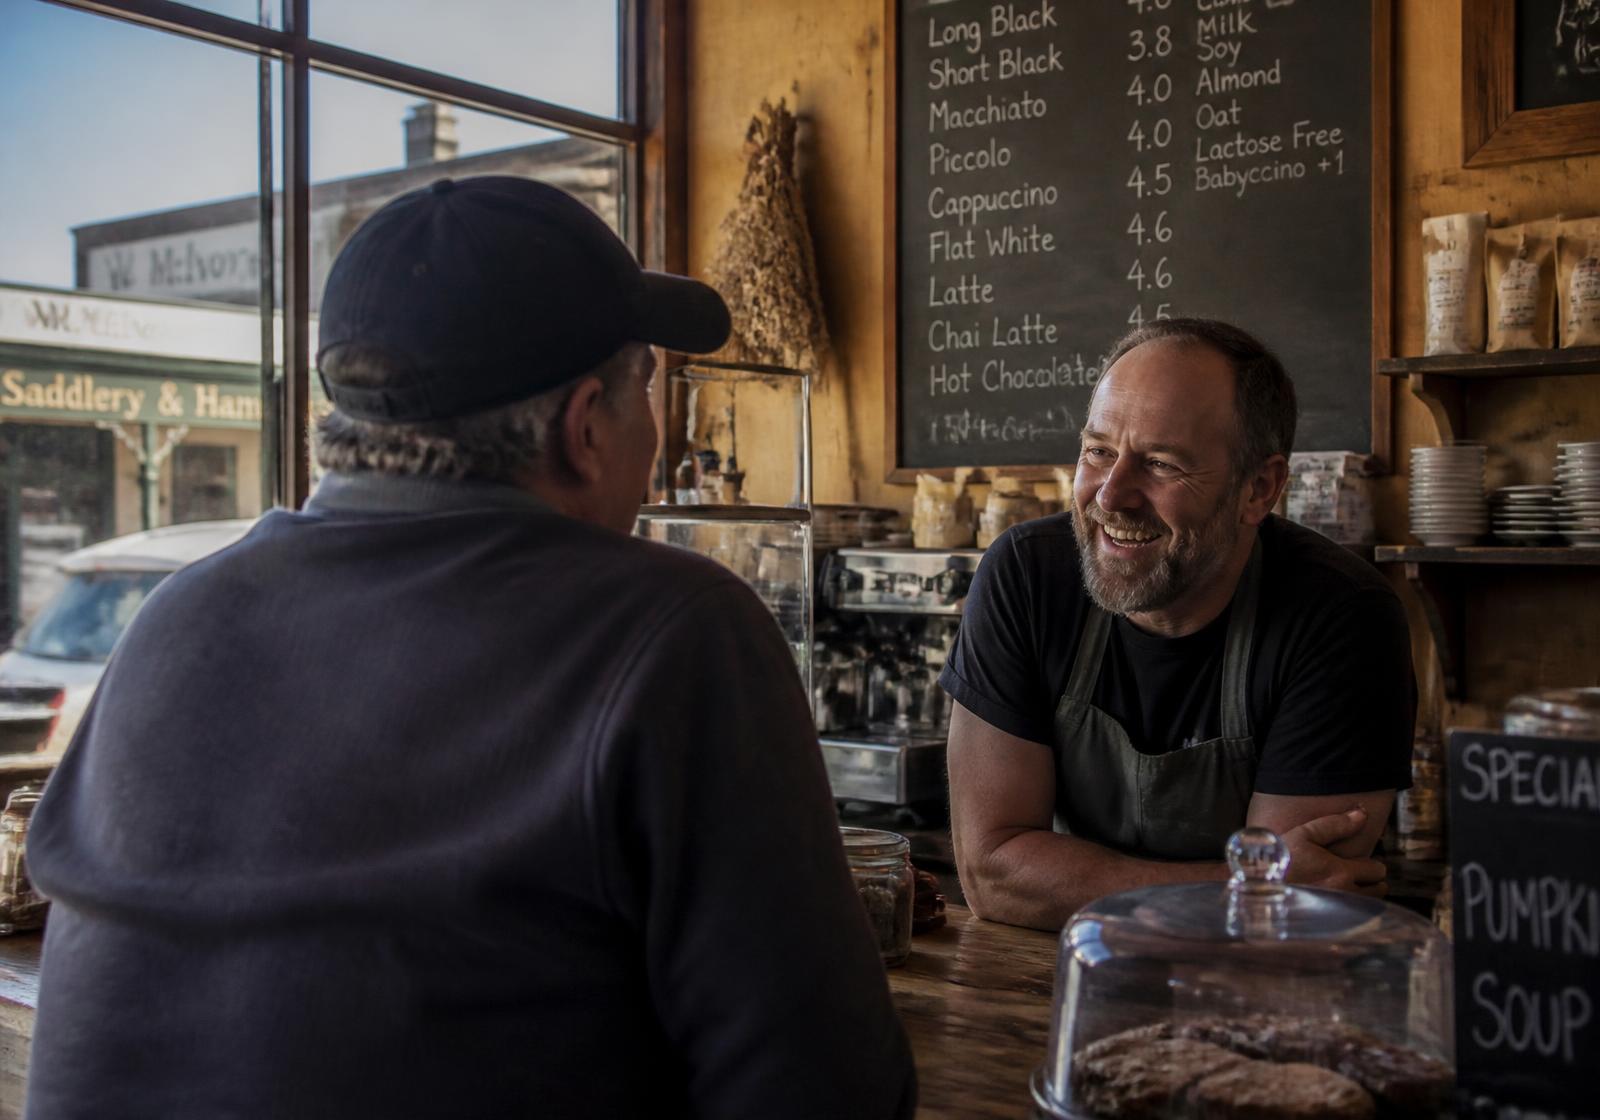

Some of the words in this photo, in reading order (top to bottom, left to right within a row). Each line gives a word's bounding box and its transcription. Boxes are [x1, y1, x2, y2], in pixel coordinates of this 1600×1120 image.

[929, 17, 981, 54] Long
[991, 0, 1058, 37] Black
[1198, 8, 1258, 37] Milk
[1127, 25, 1173, 61] 3.8
[1196, 34, 1242, 67] Soy
[928, 54, 991, 90] Short
[999, 42, 1065, 80] Black
[1195, 58, 1282, 96] Almond
[1126, 73, 1172, 106] 4.0
[928, 90, 1047, 133] Macchiato
[1196, 98, 1242, 130] Oat
[1126, 118, 1172, 152] 4.0
[1196, 131, 1283, 163] Lactose
[1293, 119, 1344, 149] Free
[929, 137, 1012, 176] Piccolo
[1195, 159, 1306, 198] Babyccino
[1317, 149, 1344, 176] +1
[1126, 162, 1172, 199] 4.5
[928, 182, 1058, 227] Cappuccino
[929, 229, 976, 264] Flat
[985, 223, 1056, 257] White
[1126, 210, 1173, 246] 4.6
[929, 273, 995, 307] Latte
[1126, 256, 1173, 291] 4.6
[928, 319, 980, 352] Chai
[992, 313, 1059, 347] Latte
[0, 368, 145, 421] Saddlery
[156, 378, 185, 416] &
[929, 362, 972, 397] Hot
[981, 353, 1099, 392] Chocolate
[1459, 742, 1600, 811] SPECIA
[1460, 861, 1600, 957] PUMPKI
[1470, 971, 1591, 1064] SOUP
